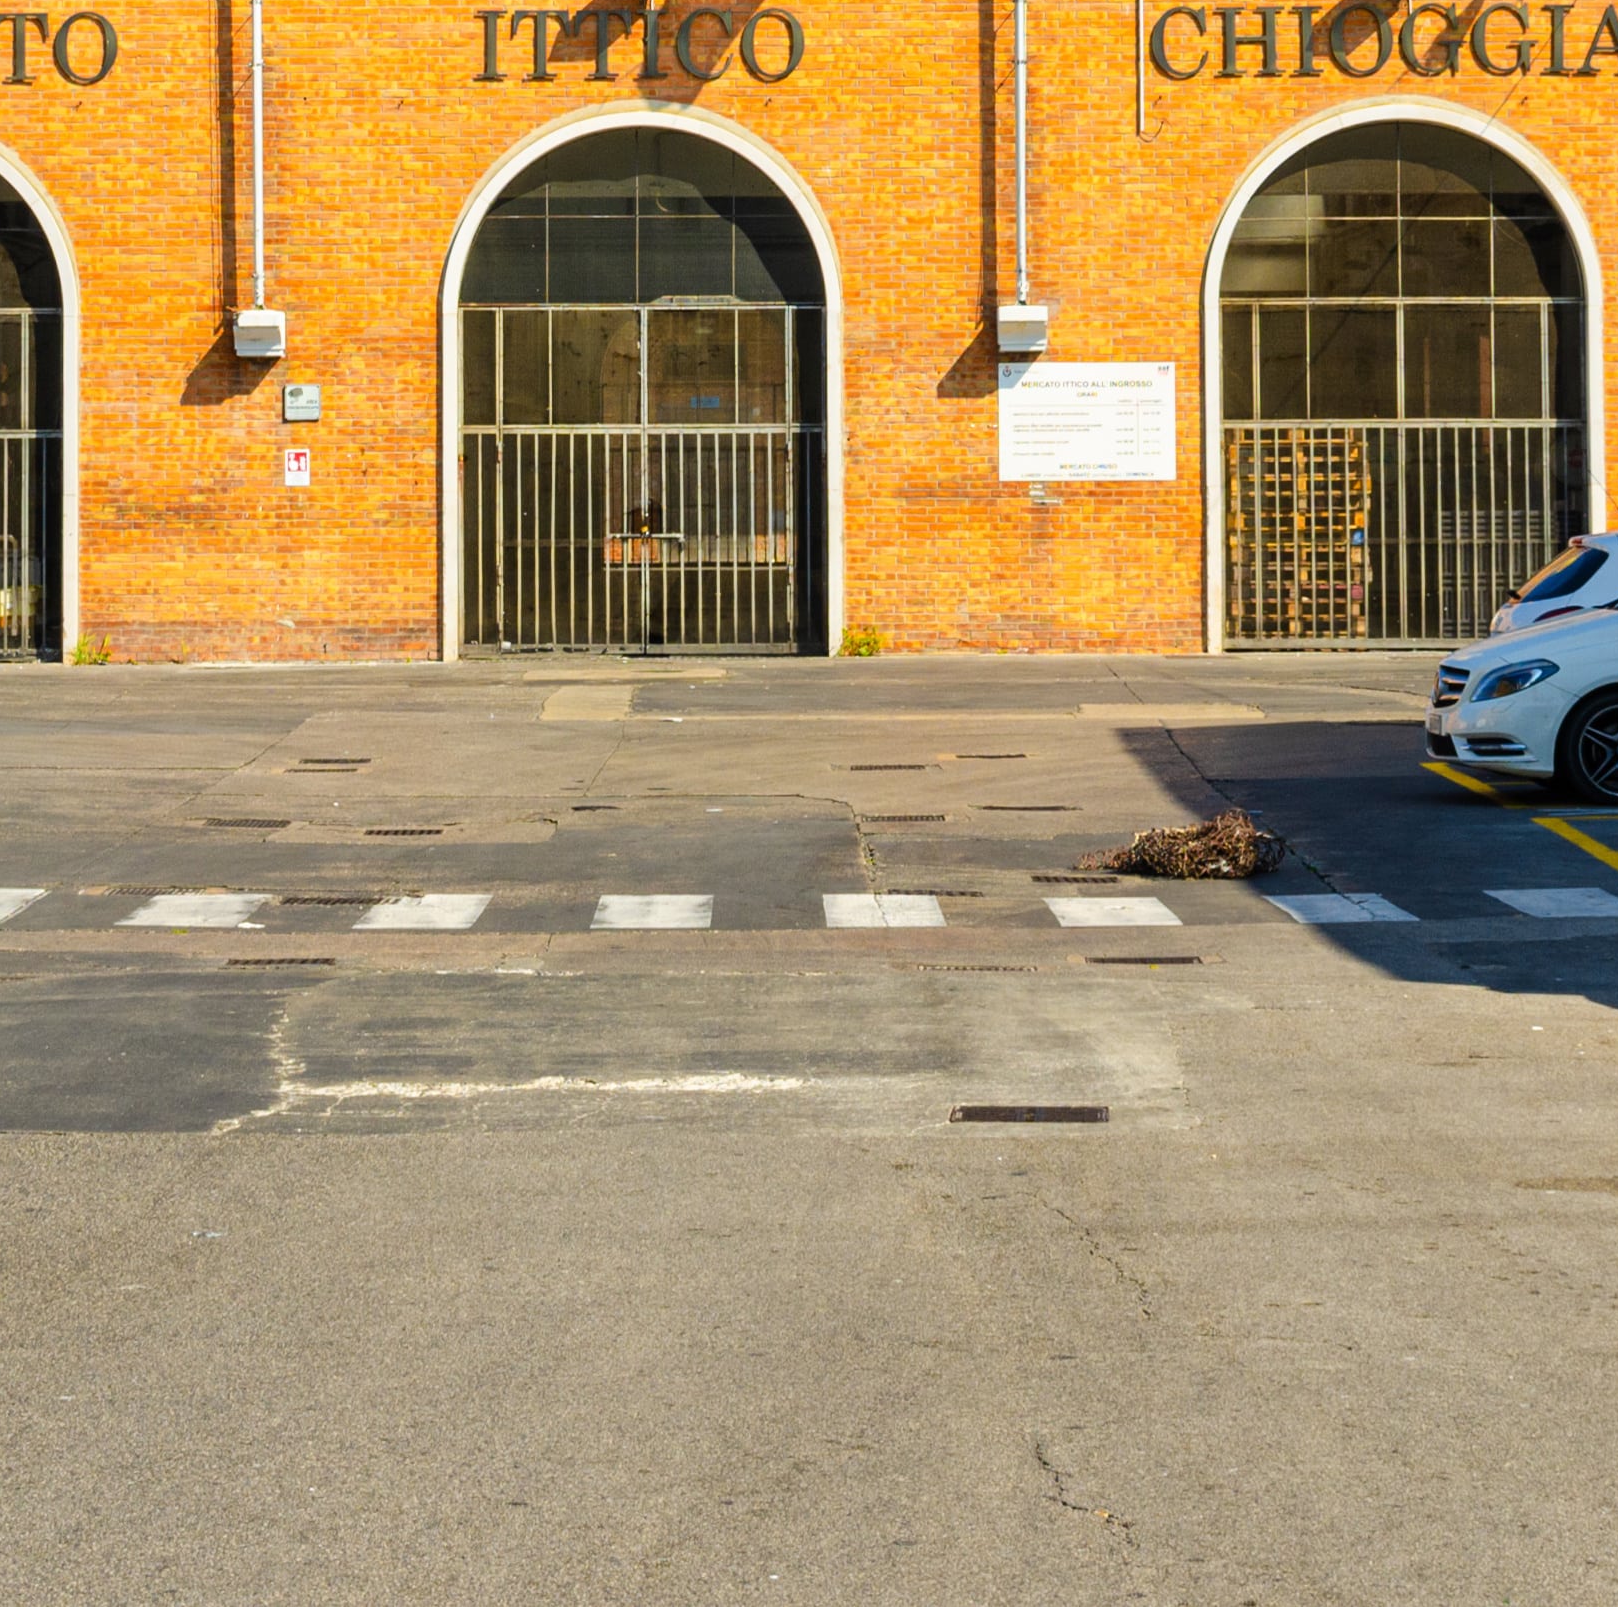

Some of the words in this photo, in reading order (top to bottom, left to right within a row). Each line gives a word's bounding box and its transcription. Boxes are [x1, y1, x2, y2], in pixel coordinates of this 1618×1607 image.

[472, 7, 805, 83] ITTICO
[1021, 380, 1061, 389] MERCATO
[1062, 380, 1089, 389] ITTICO
[1109, 380, 1153, 388] INGROSSO
